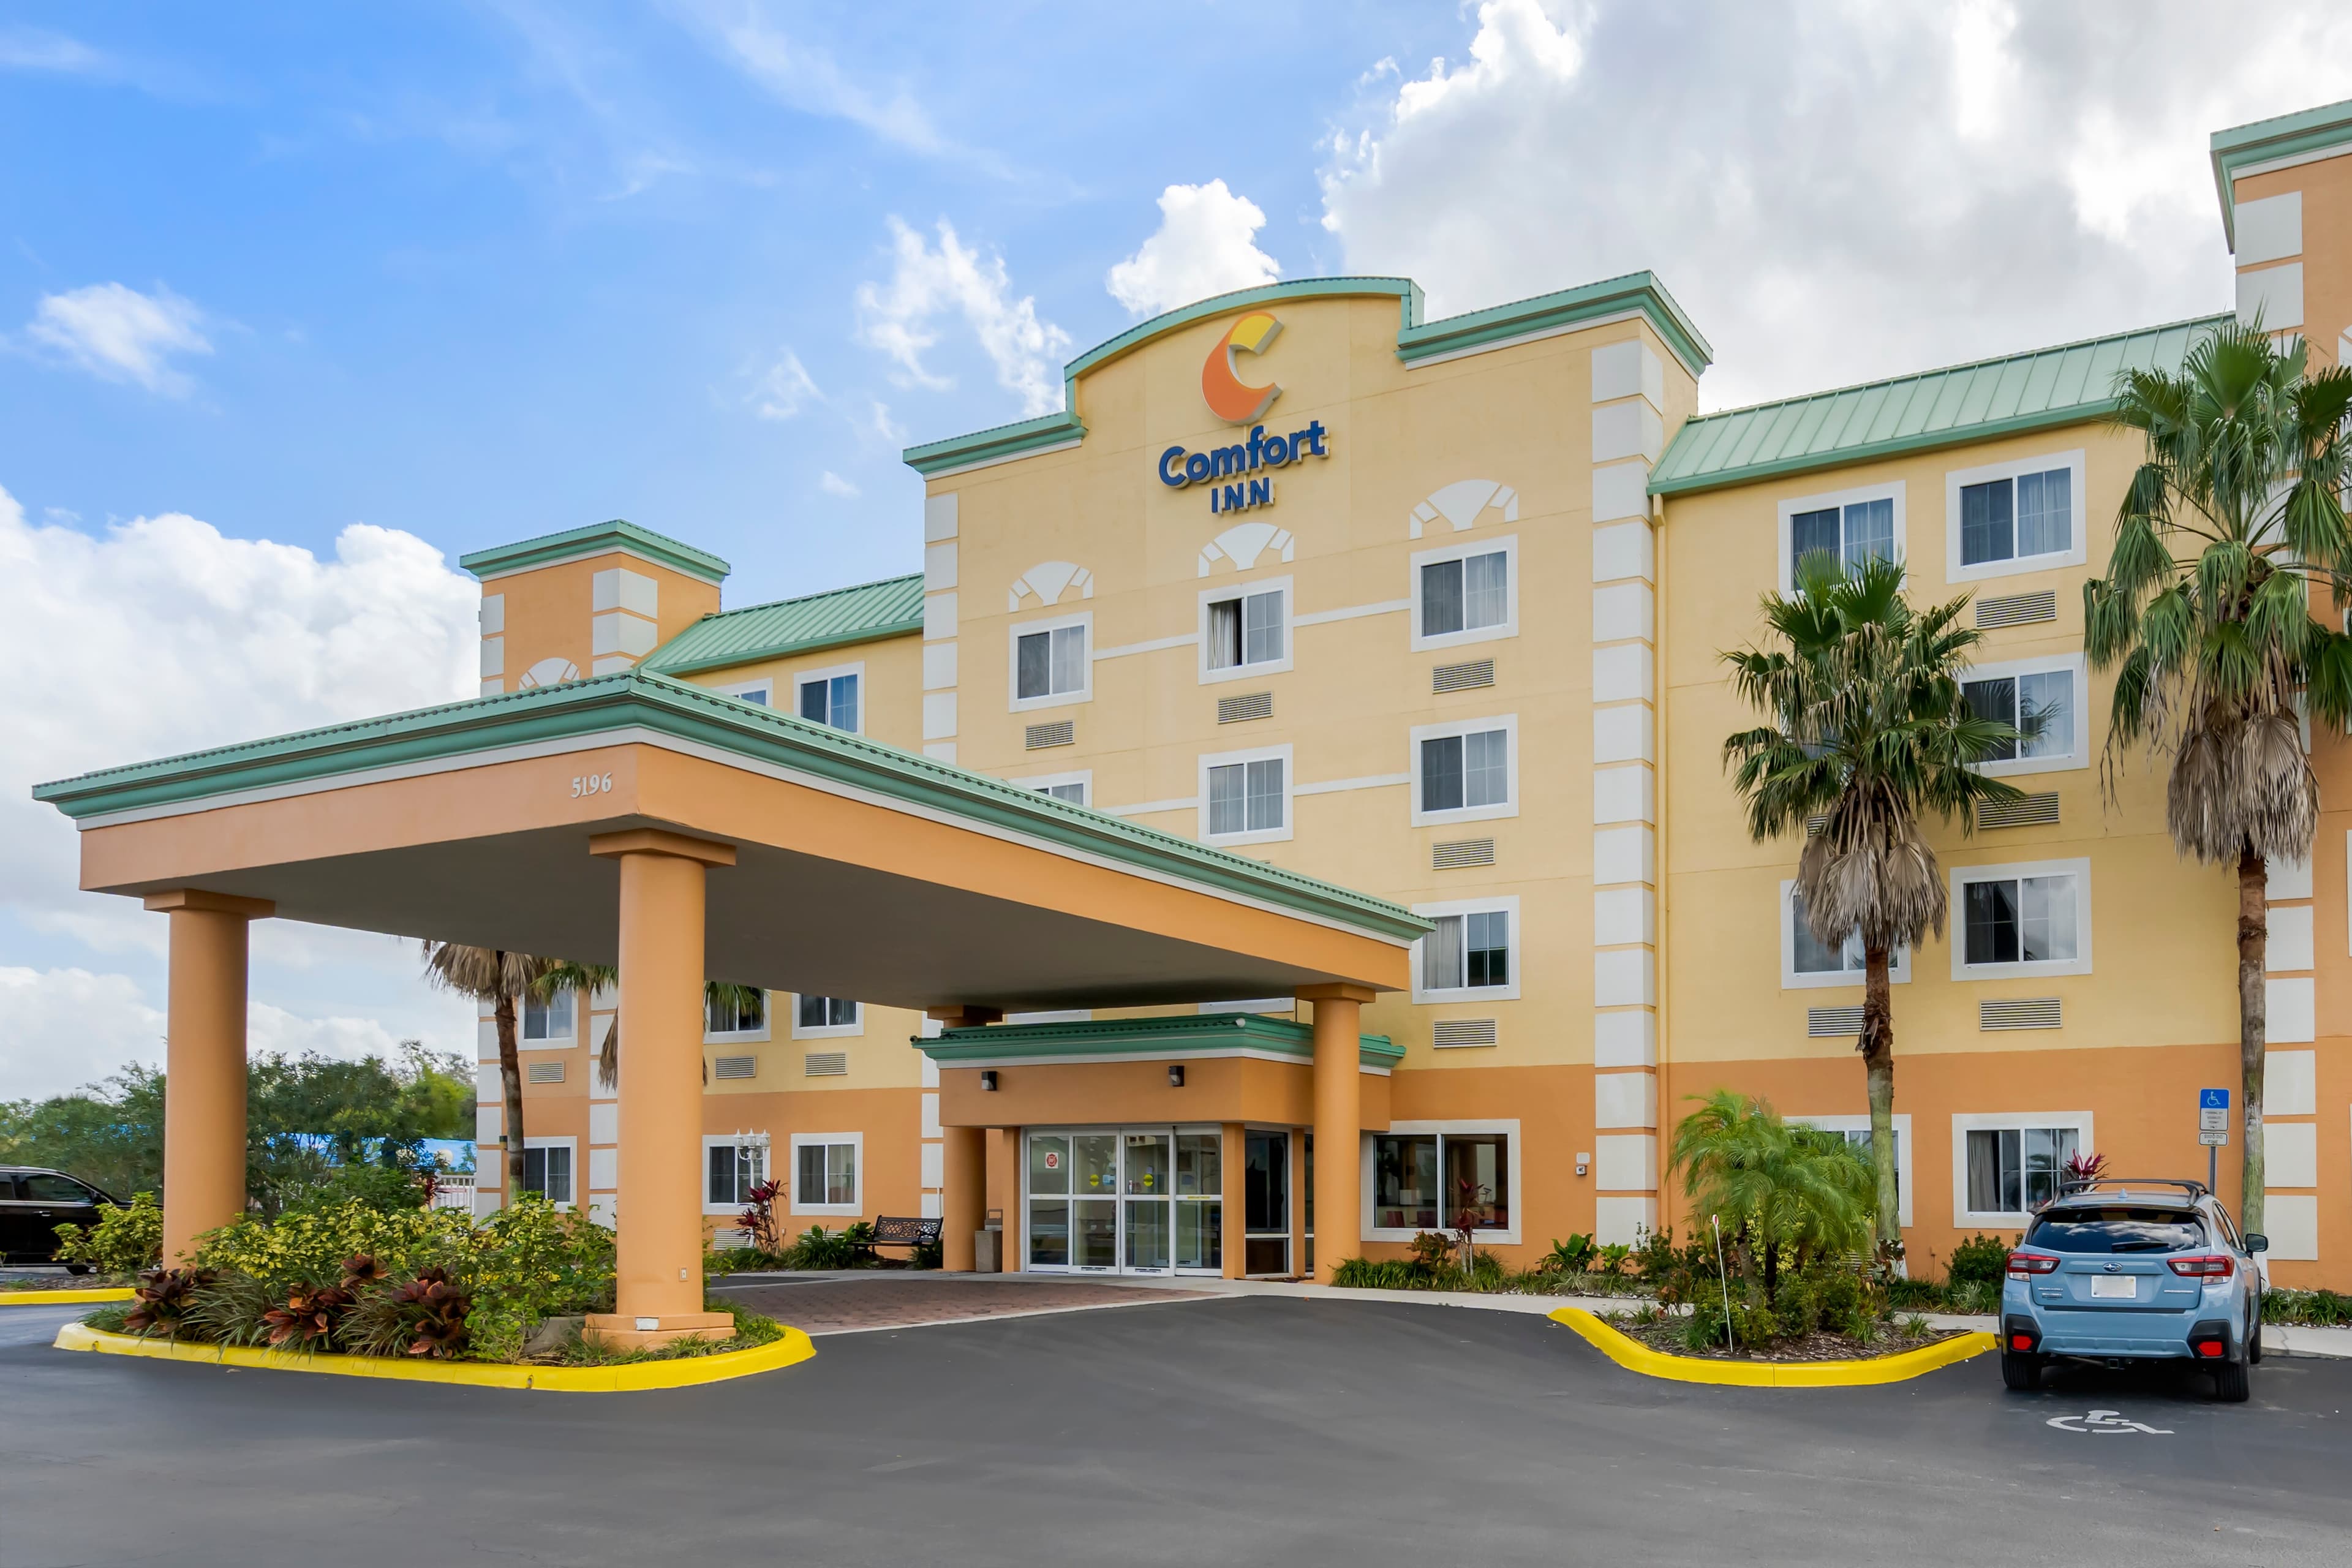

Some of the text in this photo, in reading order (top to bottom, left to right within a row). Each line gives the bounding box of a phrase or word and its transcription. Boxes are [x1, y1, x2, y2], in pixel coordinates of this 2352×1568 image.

[1159, 420, 1329, 488] Comfort
[1212, 477, 1274, 514] INN
[571, 772, 612, 798] 5196
